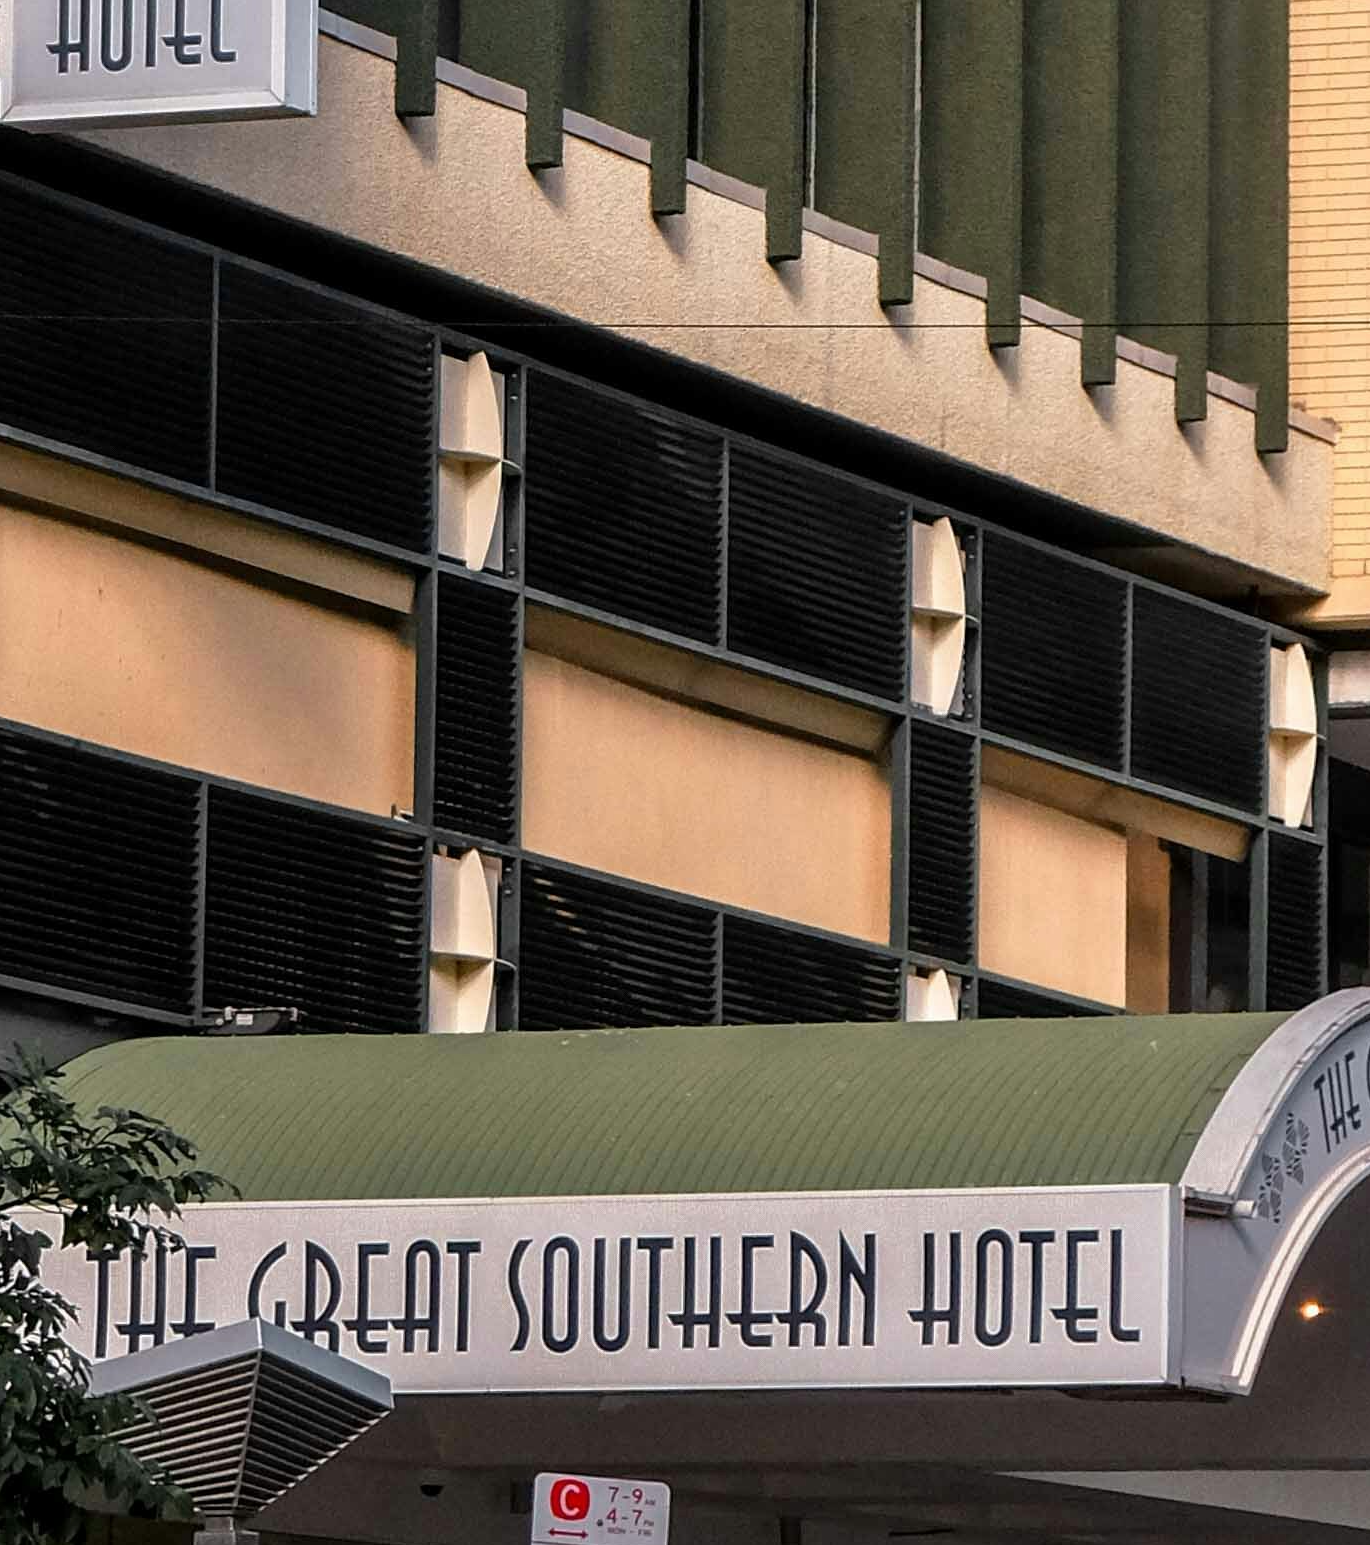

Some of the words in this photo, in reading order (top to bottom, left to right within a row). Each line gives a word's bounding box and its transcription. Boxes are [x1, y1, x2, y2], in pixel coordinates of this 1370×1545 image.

[1313, 1051, 1362, 1155] THE
[85, 1240, 217, 1359] THE
[247, 1238, 482, 1356] GREAT
[508, 1228, 879, 1355] SOUTHERN
[907, 1226, 1142, 1347] HOTEL
